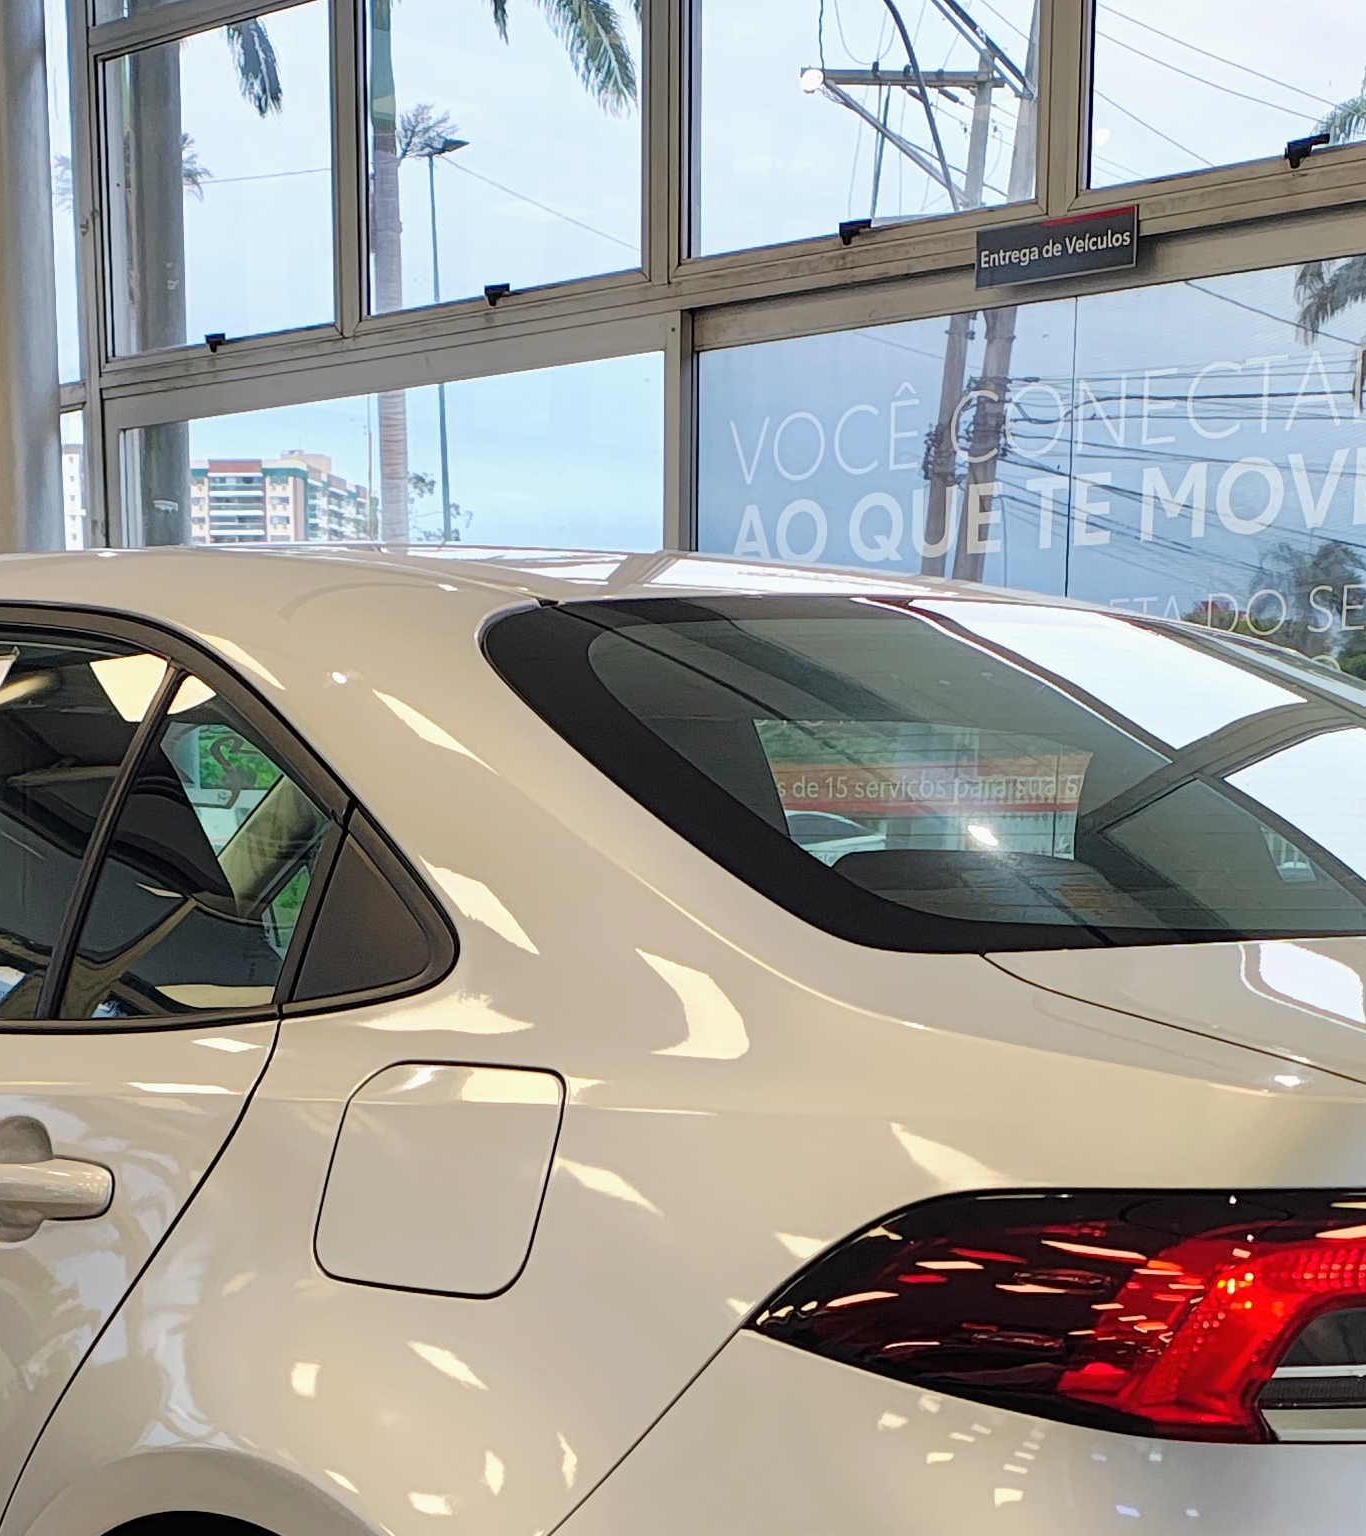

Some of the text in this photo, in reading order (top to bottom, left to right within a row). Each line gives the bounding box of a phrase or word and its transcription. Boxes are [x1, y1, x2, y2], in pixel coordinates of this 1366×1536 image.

[980, 228, 1131, 269] Entrega de Veículos
[729, 381, 920, 486] VOCÊ
[733, 498, 828, 564] AO
[848, 481, 1003, 563] QUE
[1026, 471, 1113, 550] TE
[1206, 588, 1288, 636] DO
[792, 774, 819, 798] de
[825, 774, 849, 799] 15
[953, 778, 1007, 804] para
